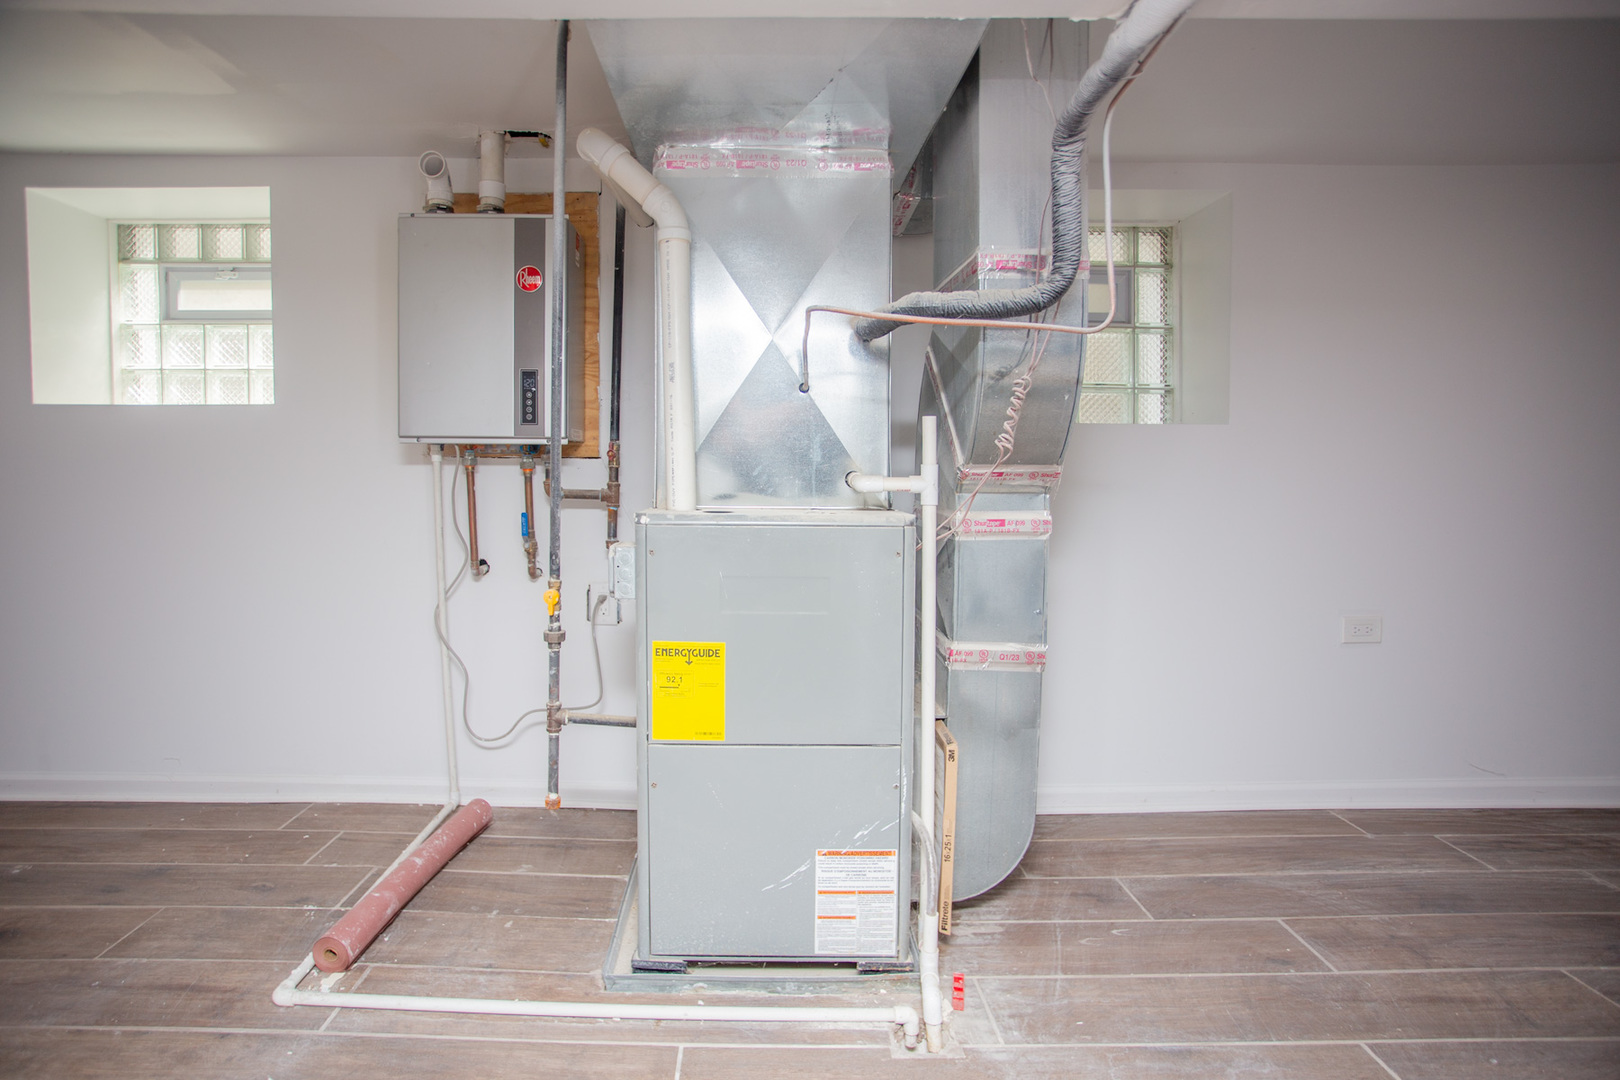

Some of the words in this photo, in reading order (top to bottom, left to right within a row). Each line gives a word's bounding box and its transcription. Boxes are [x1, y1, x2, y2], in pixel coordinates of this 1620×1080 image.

[520, 268, 540, 288] Rheem
[974, 519, 1005, 528] Shurtape
[655, 648, 720, 658] ENERGYGUIDE
[948, 749, 956, 762] 3M
[941, 900, 949, 931] Filtrete
